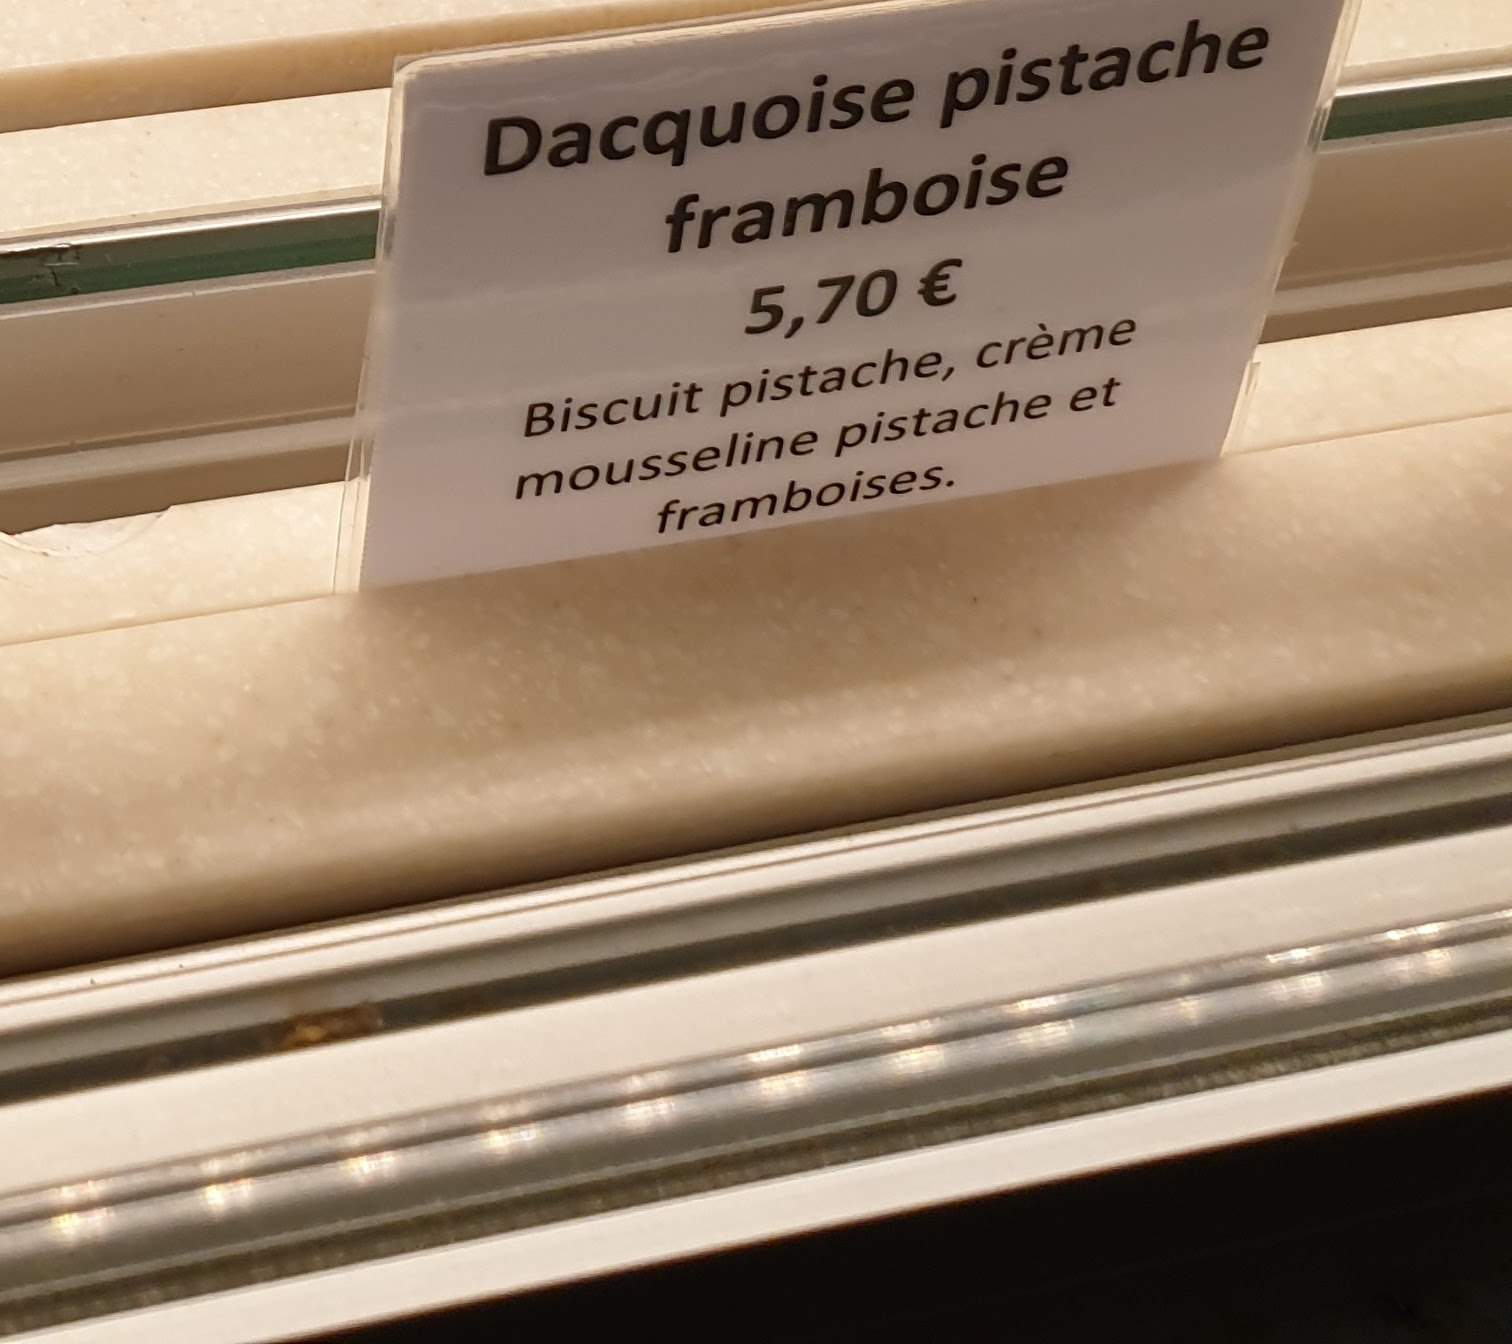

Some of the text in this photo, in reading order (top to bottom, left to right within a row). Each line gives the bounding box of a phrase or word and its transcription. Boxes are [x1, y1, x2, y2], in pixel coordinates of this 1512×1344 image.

[484, 19, 1269, 176] Dacquoise pistache
[665, 154, 1068, 253] framboise
[745, 258, 963, 339] 5,70 €
[524, 320, 1136, 437] Biscuit pistache, crème
[516, 378, 1120, 499] mousseline pistache et
[658, 467, 954, 533] framboises.
